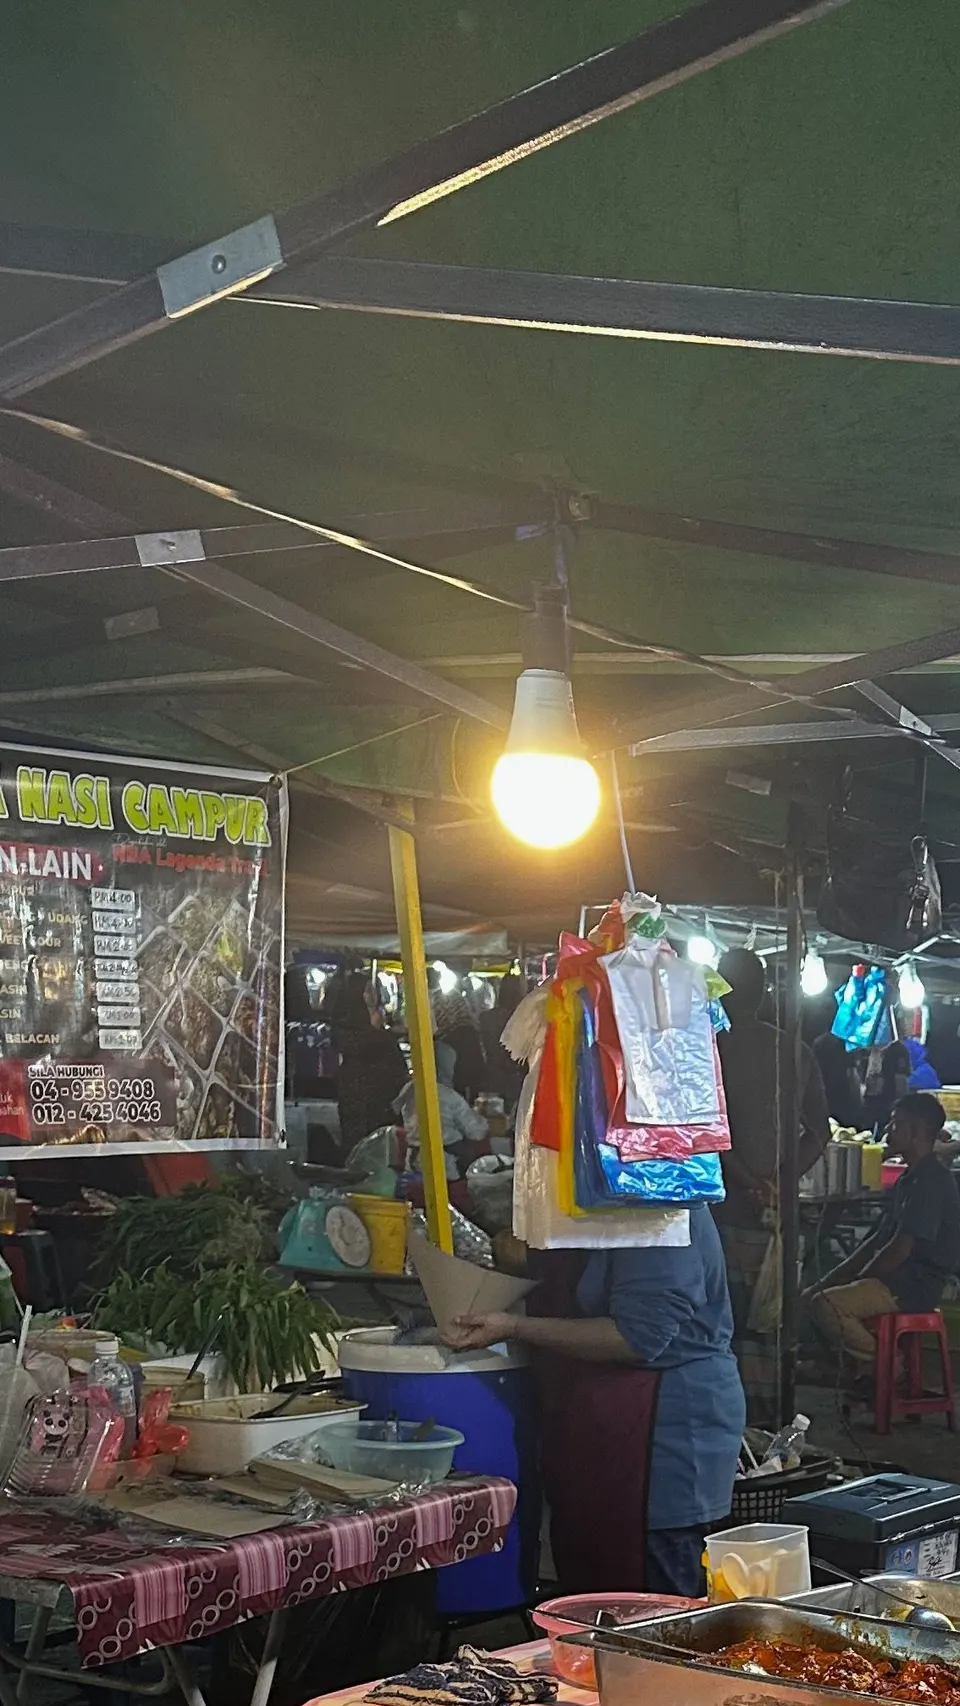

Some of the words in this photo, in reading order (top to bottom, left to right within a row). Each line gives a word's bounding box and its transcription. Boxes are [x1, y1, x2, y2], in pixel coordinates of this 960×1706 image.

[17, 766, 114, 830] NASI
[122, 780, 272, 848] CAMPUR
[5, 1032, 60, 1045] BELACAN
[28, 1064, 55, 1079] SILA
[56, 1065, 105, 1079] HUBUNGI
[30, 1079, 59, 1101] 04
[71, 1078, 107, 1102] 955
[108, 1079, 155, 1101] 9408
[32, 1102, 66, 1125] 012
[79, 1103, 114, 1124] 425
[115, 1101, 161, 1123] 4046
